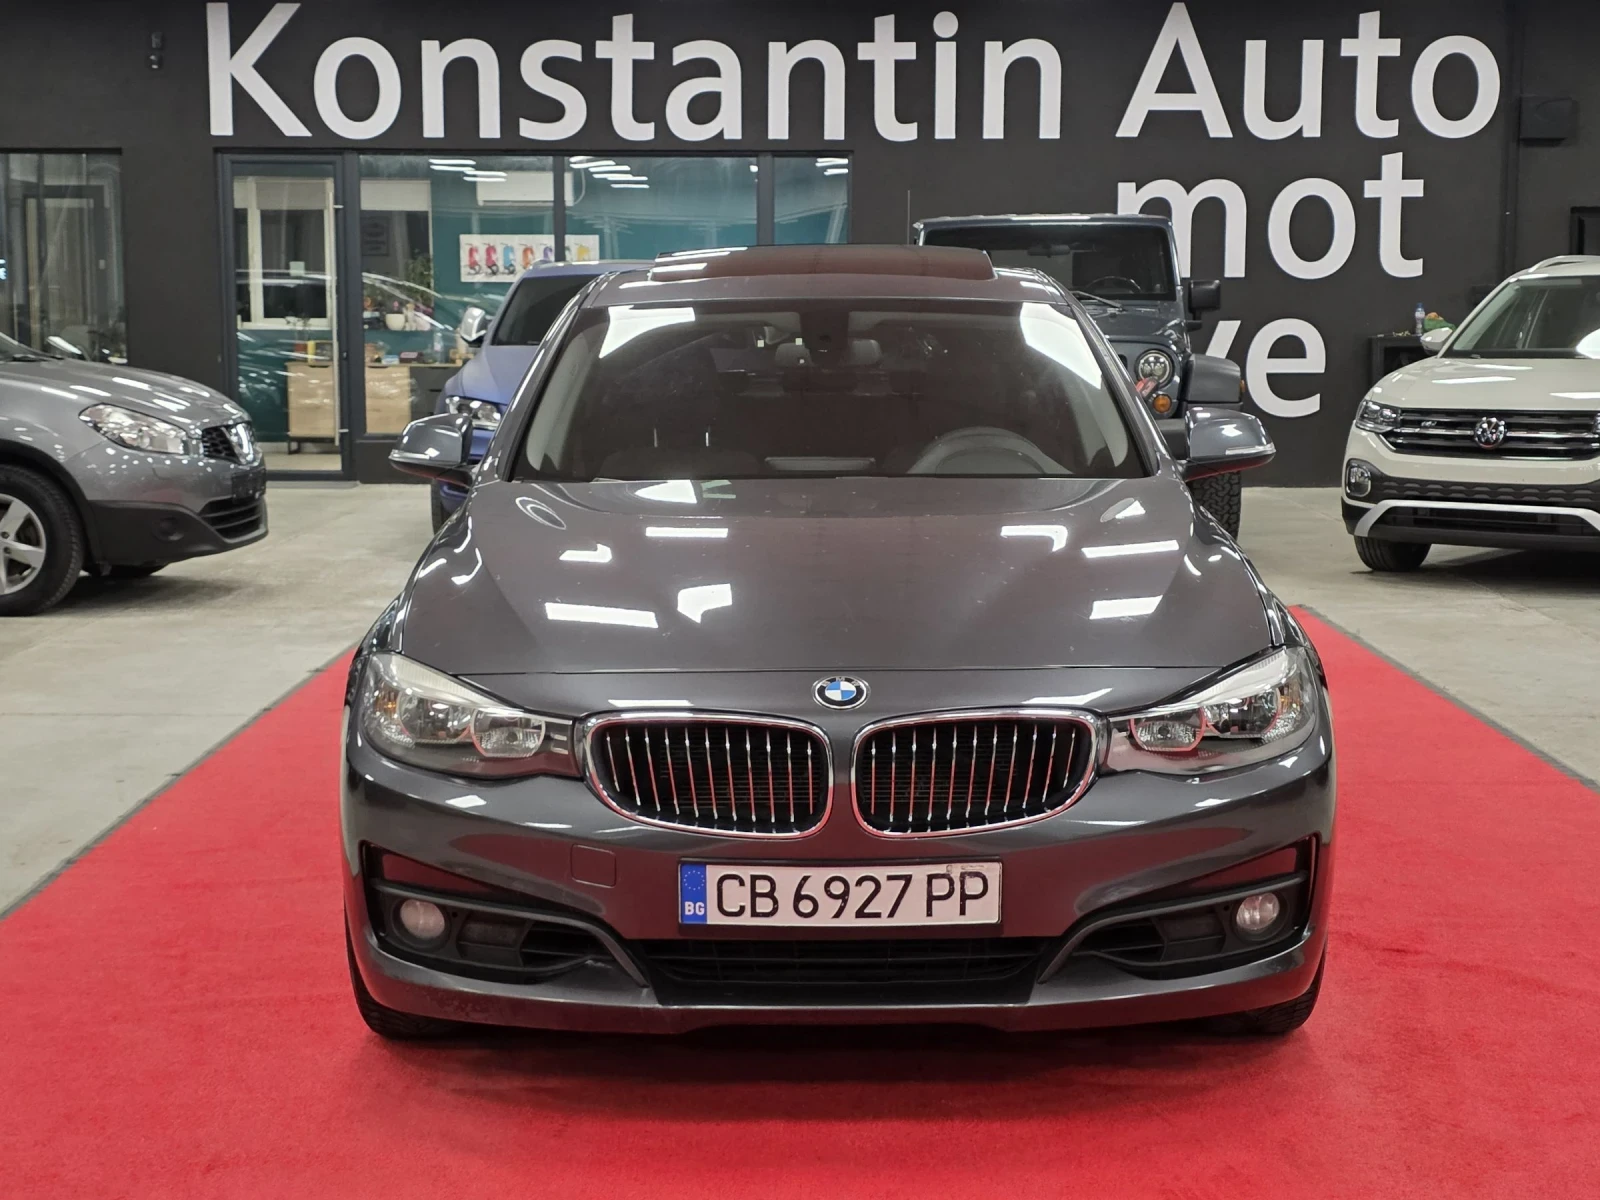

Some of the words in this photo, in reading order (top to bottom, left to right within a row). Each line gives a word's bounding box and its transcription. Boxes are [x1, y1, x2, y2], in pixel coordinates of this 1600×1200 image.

[207, 4, 1062, 141] Konstantin
[1116, 3, 1501, 140] Auto
[1117, 152, 1425, 280] mot
[684, 901, 705, 916] BG
[716, 873, 779, 918] CB
[793, 874, 913, 919] 6927
[926, 871, 989, 917] PP
